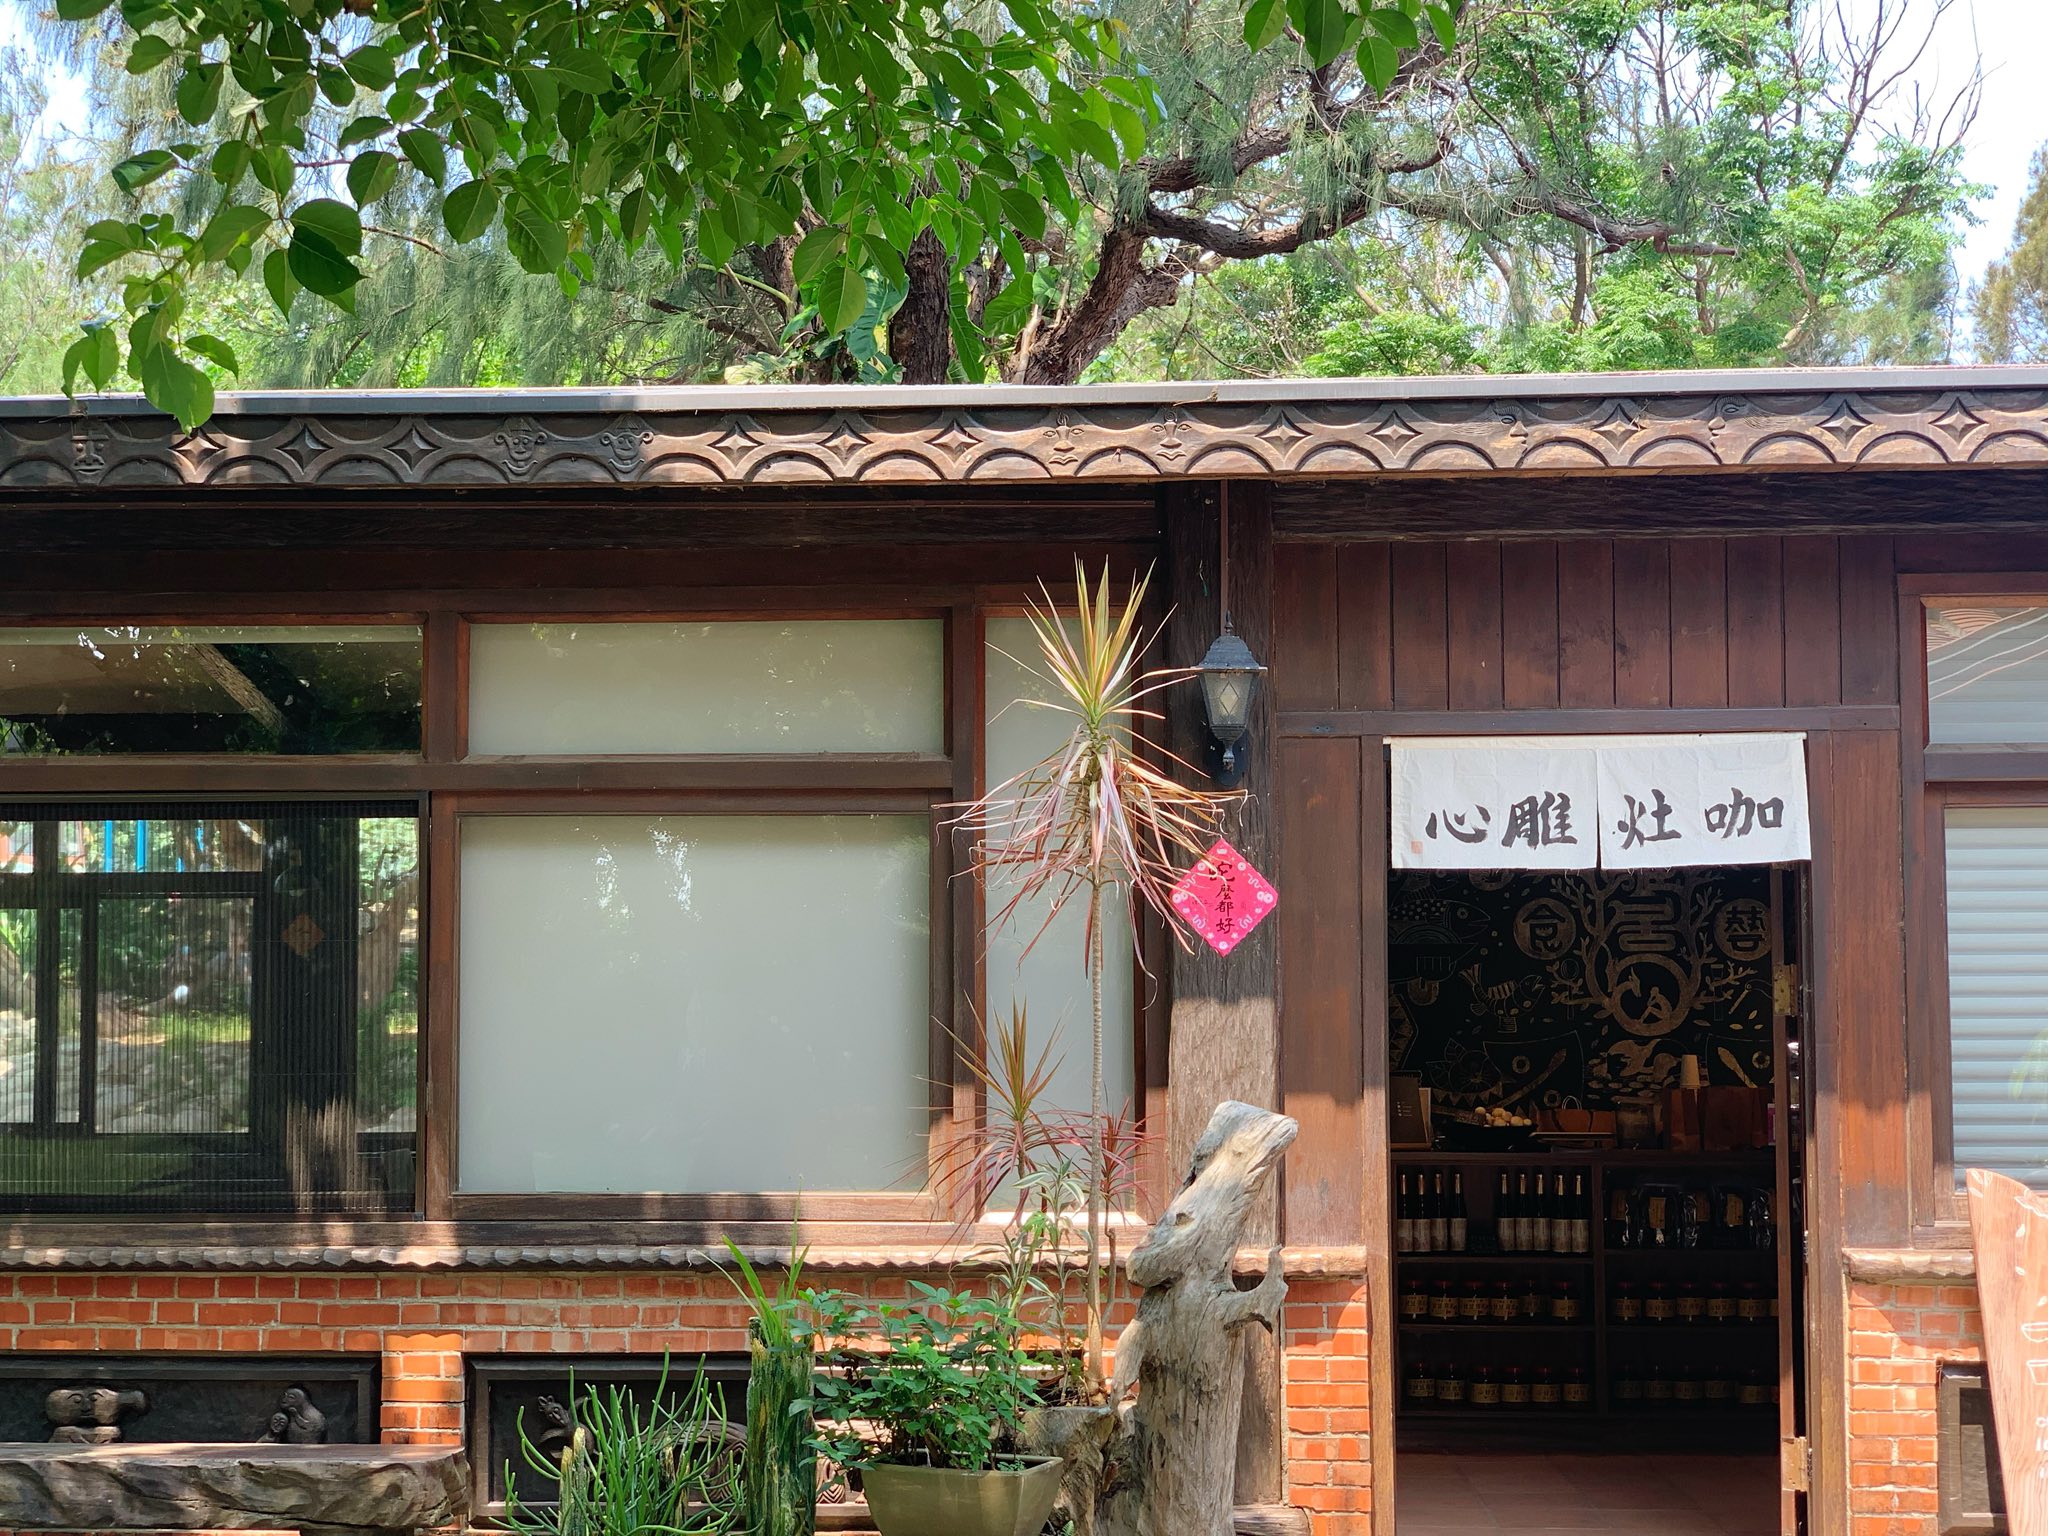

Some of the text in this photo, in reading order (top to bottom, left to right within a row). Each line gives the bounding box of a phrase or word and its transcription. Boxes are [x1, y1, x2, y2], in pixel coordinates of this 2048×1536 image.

[1424, 786, 1785, 850] 心雕灶咖
[1209, 862, 1236, 934] 蛇麼都好
